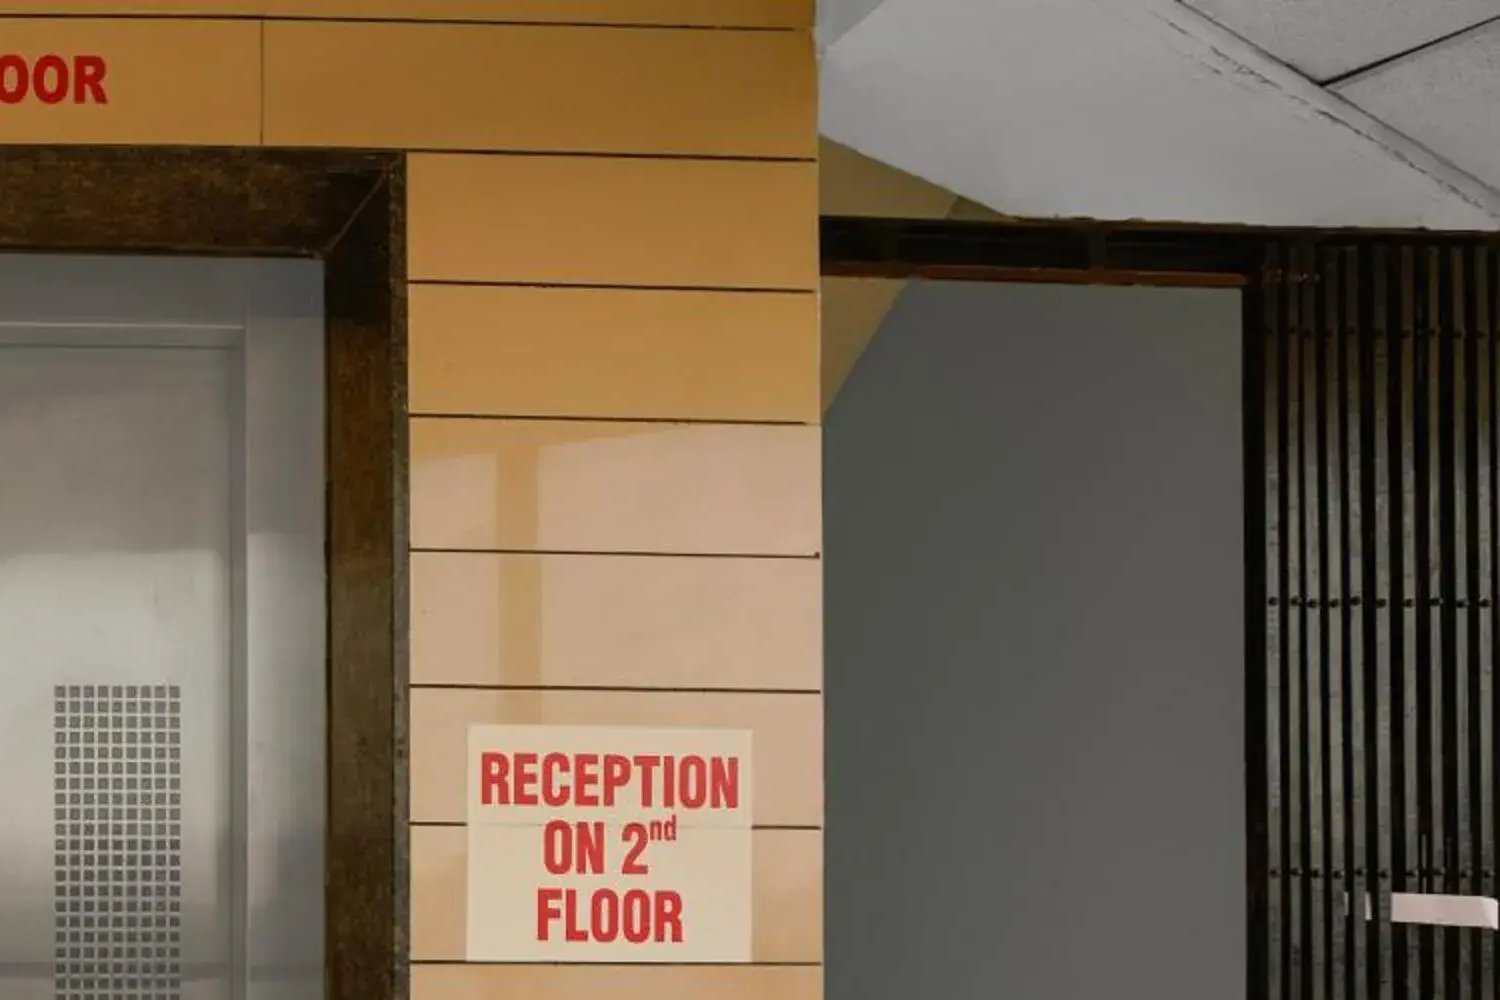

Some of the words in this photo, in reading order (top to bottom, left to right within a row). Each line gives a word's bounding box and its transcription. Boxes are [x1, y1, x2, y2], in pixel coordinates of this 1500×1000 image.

[481, 752, 739, 809] RECEPTION
[543, 820, 605, 875] ON
[621, 814, 677, 875] 2nd
[537, 887, 683, 943] FLOOR
